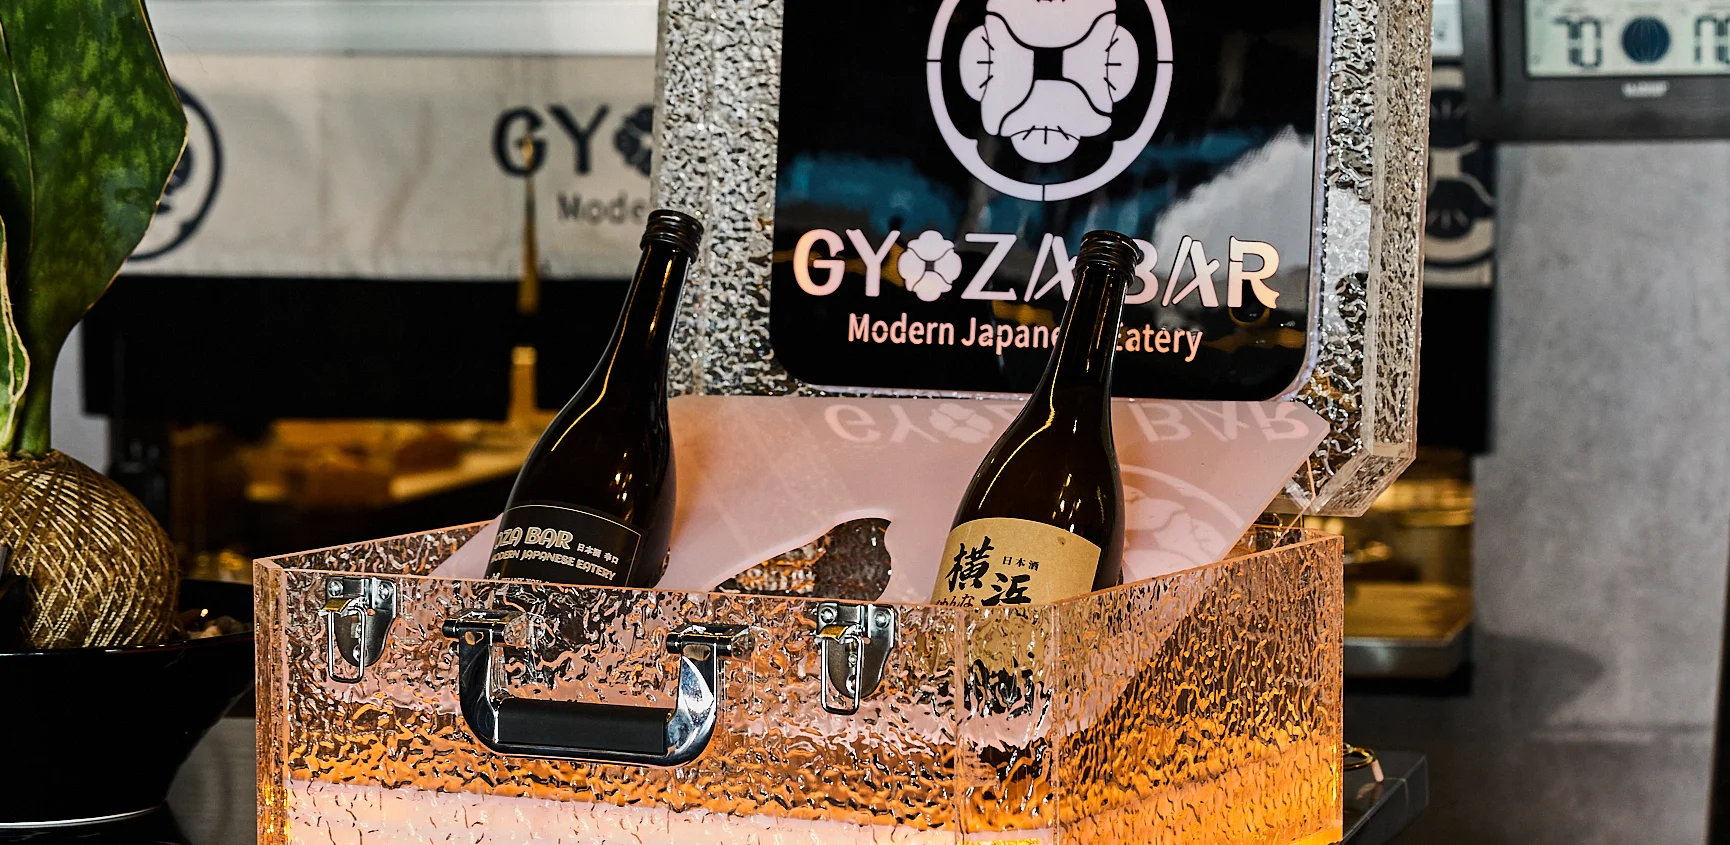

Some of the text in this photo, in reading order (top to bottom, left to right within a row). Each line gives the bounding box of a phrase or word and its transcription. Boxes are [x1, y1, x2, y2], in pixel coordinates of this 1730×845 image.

[848, 312, 955, 346] Modern
[524, 526, 574, 550] BAR
[520, 549, 576, 567] JAPANESE
[575, 559, 617, 581] EATERY
[1002, 555, 1040, 572] 日本酒
